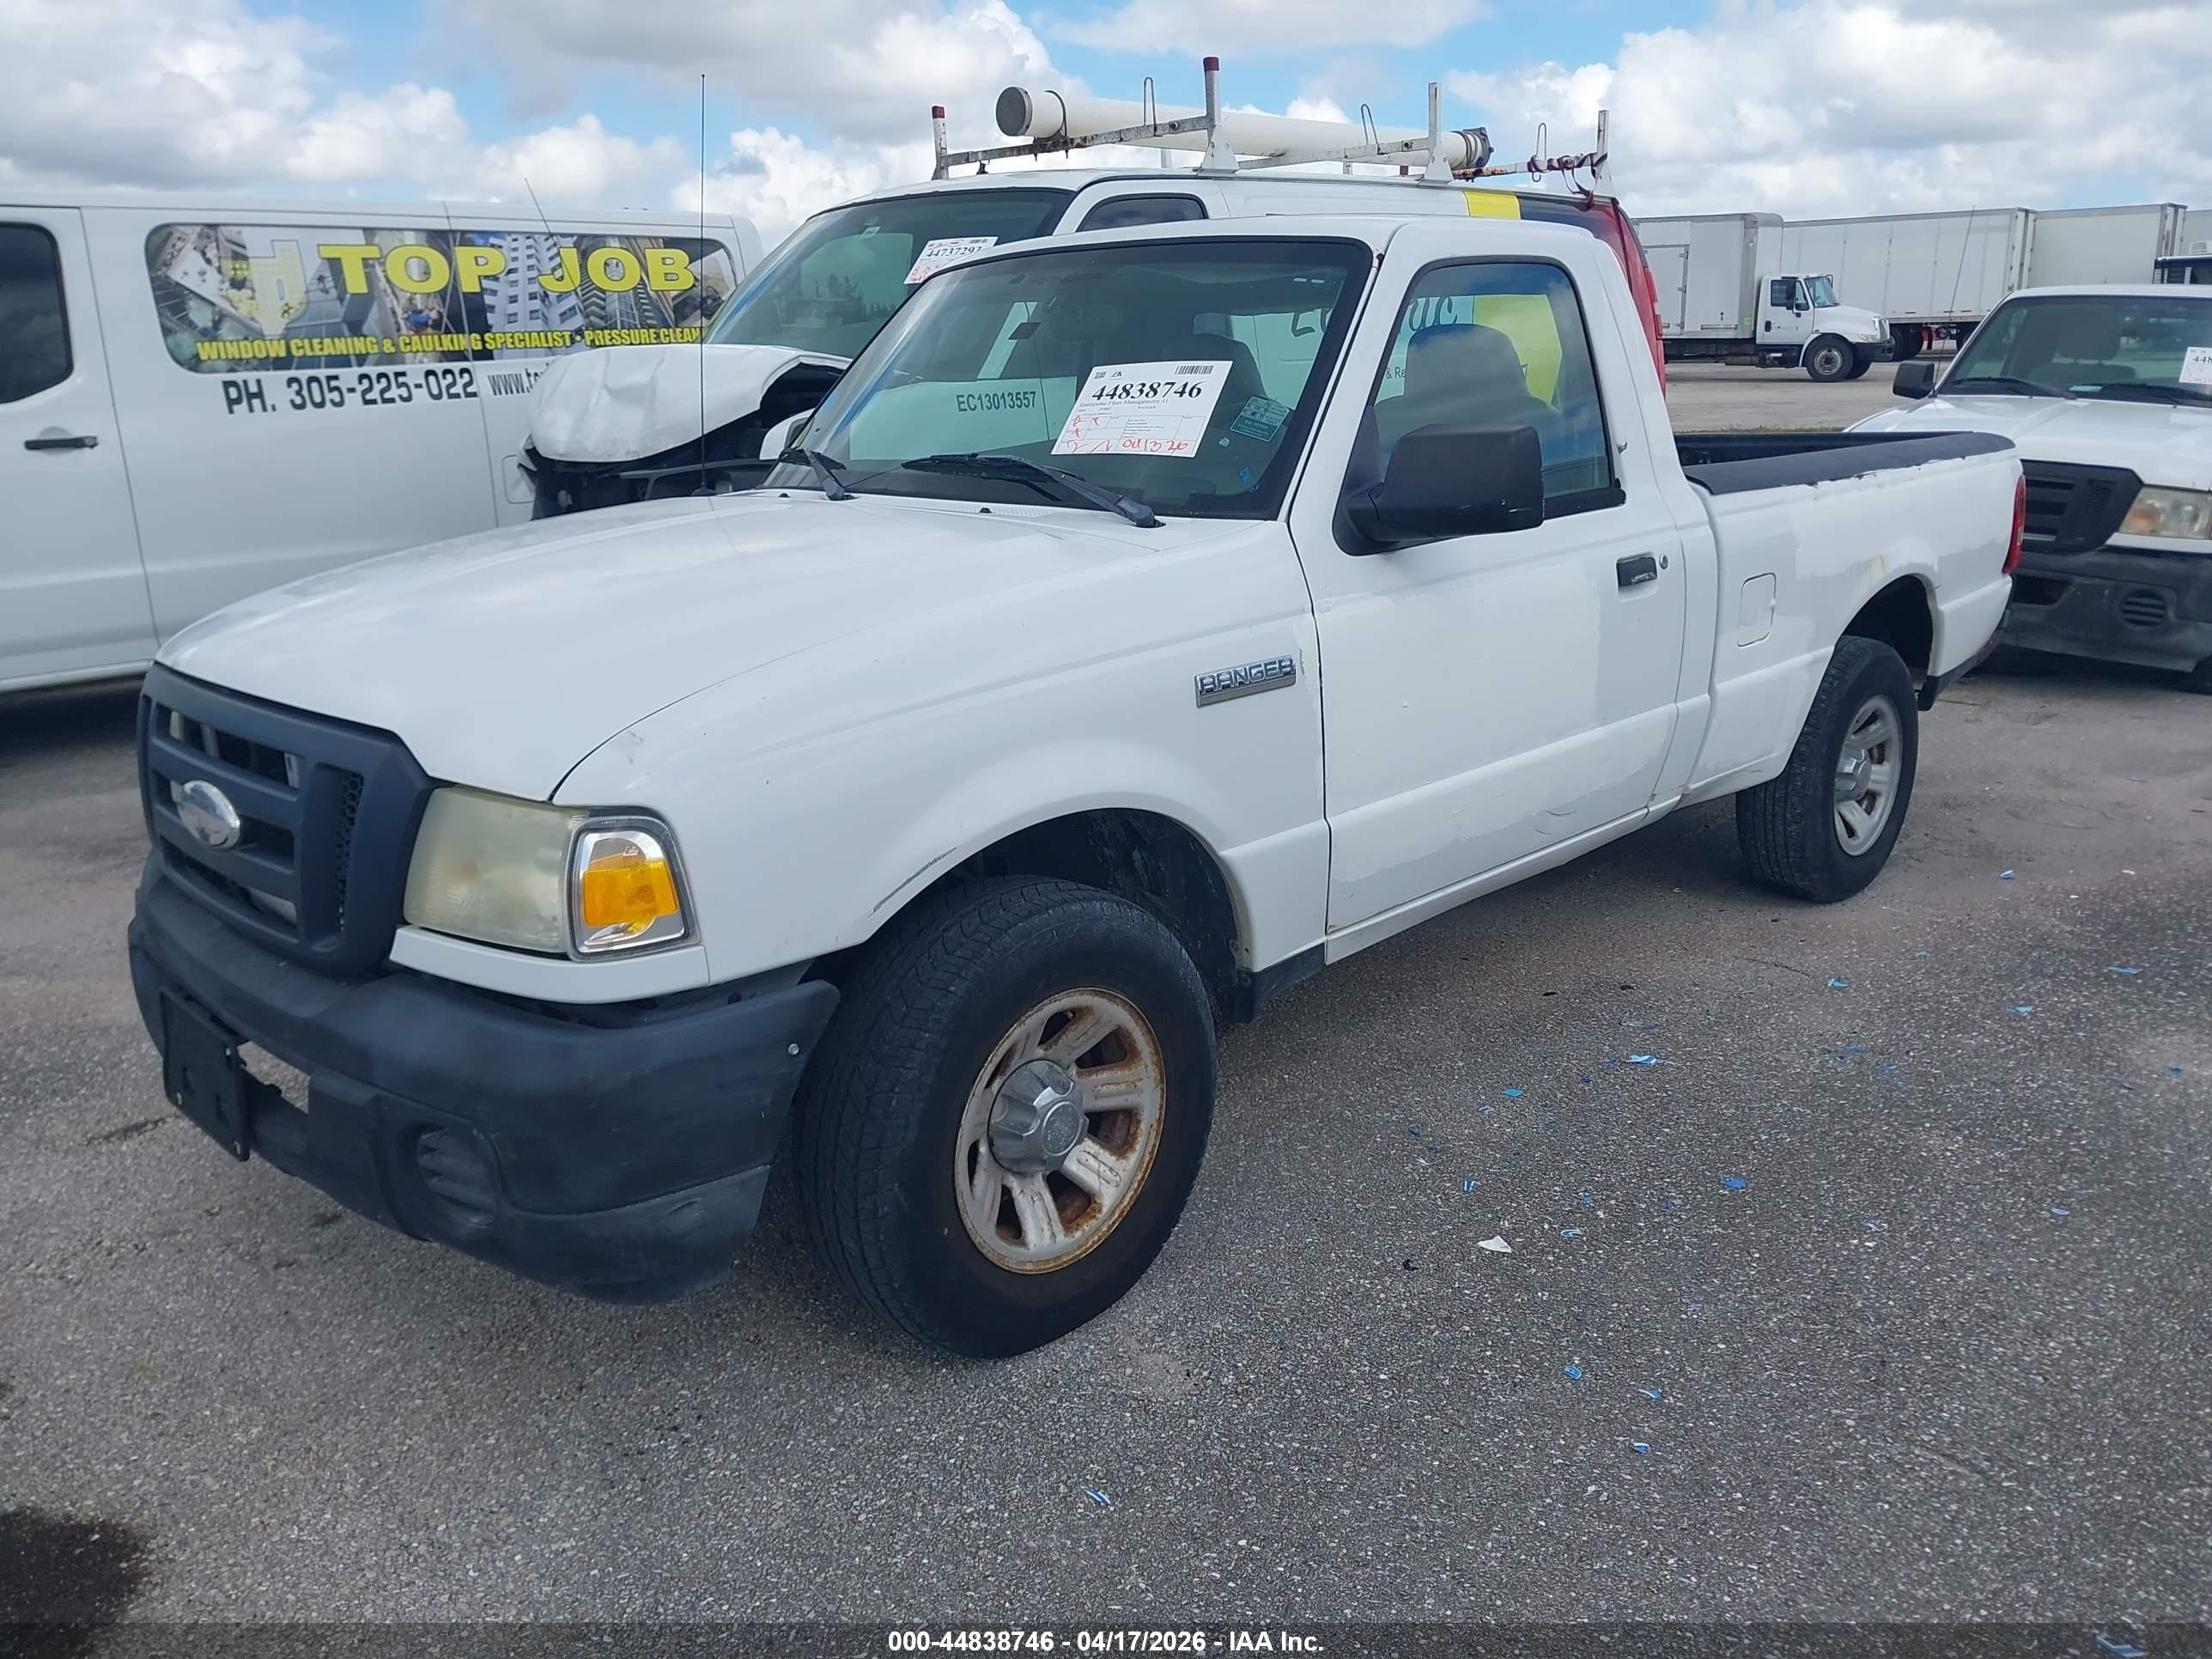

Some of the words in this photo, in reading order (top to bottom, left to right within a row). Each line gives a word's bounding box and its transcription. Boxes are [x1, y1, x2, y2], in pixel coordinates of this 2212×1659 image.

[316, 243, 507, 295] TOP
[537, 246, 696, 294] JOB
[196, 338, 288, 361] WINDOW
[289, 336, 380, 357] CLEANING
[382, 337, 396, 354] &
[398, 333, 482, 353] CAULKING
[483, 330, 572, 350] SPECIALIST
[584, 328, 658, 346] PRESSURE
[221, 378, 277, 415] PH.
[286, 367, 479, 411] 305-225-022
[955, 391, 1036, 412] EC13013557
[1091, 380, 1208, 401] 44838746
[1199, 657, 1297, 695] RANGER
